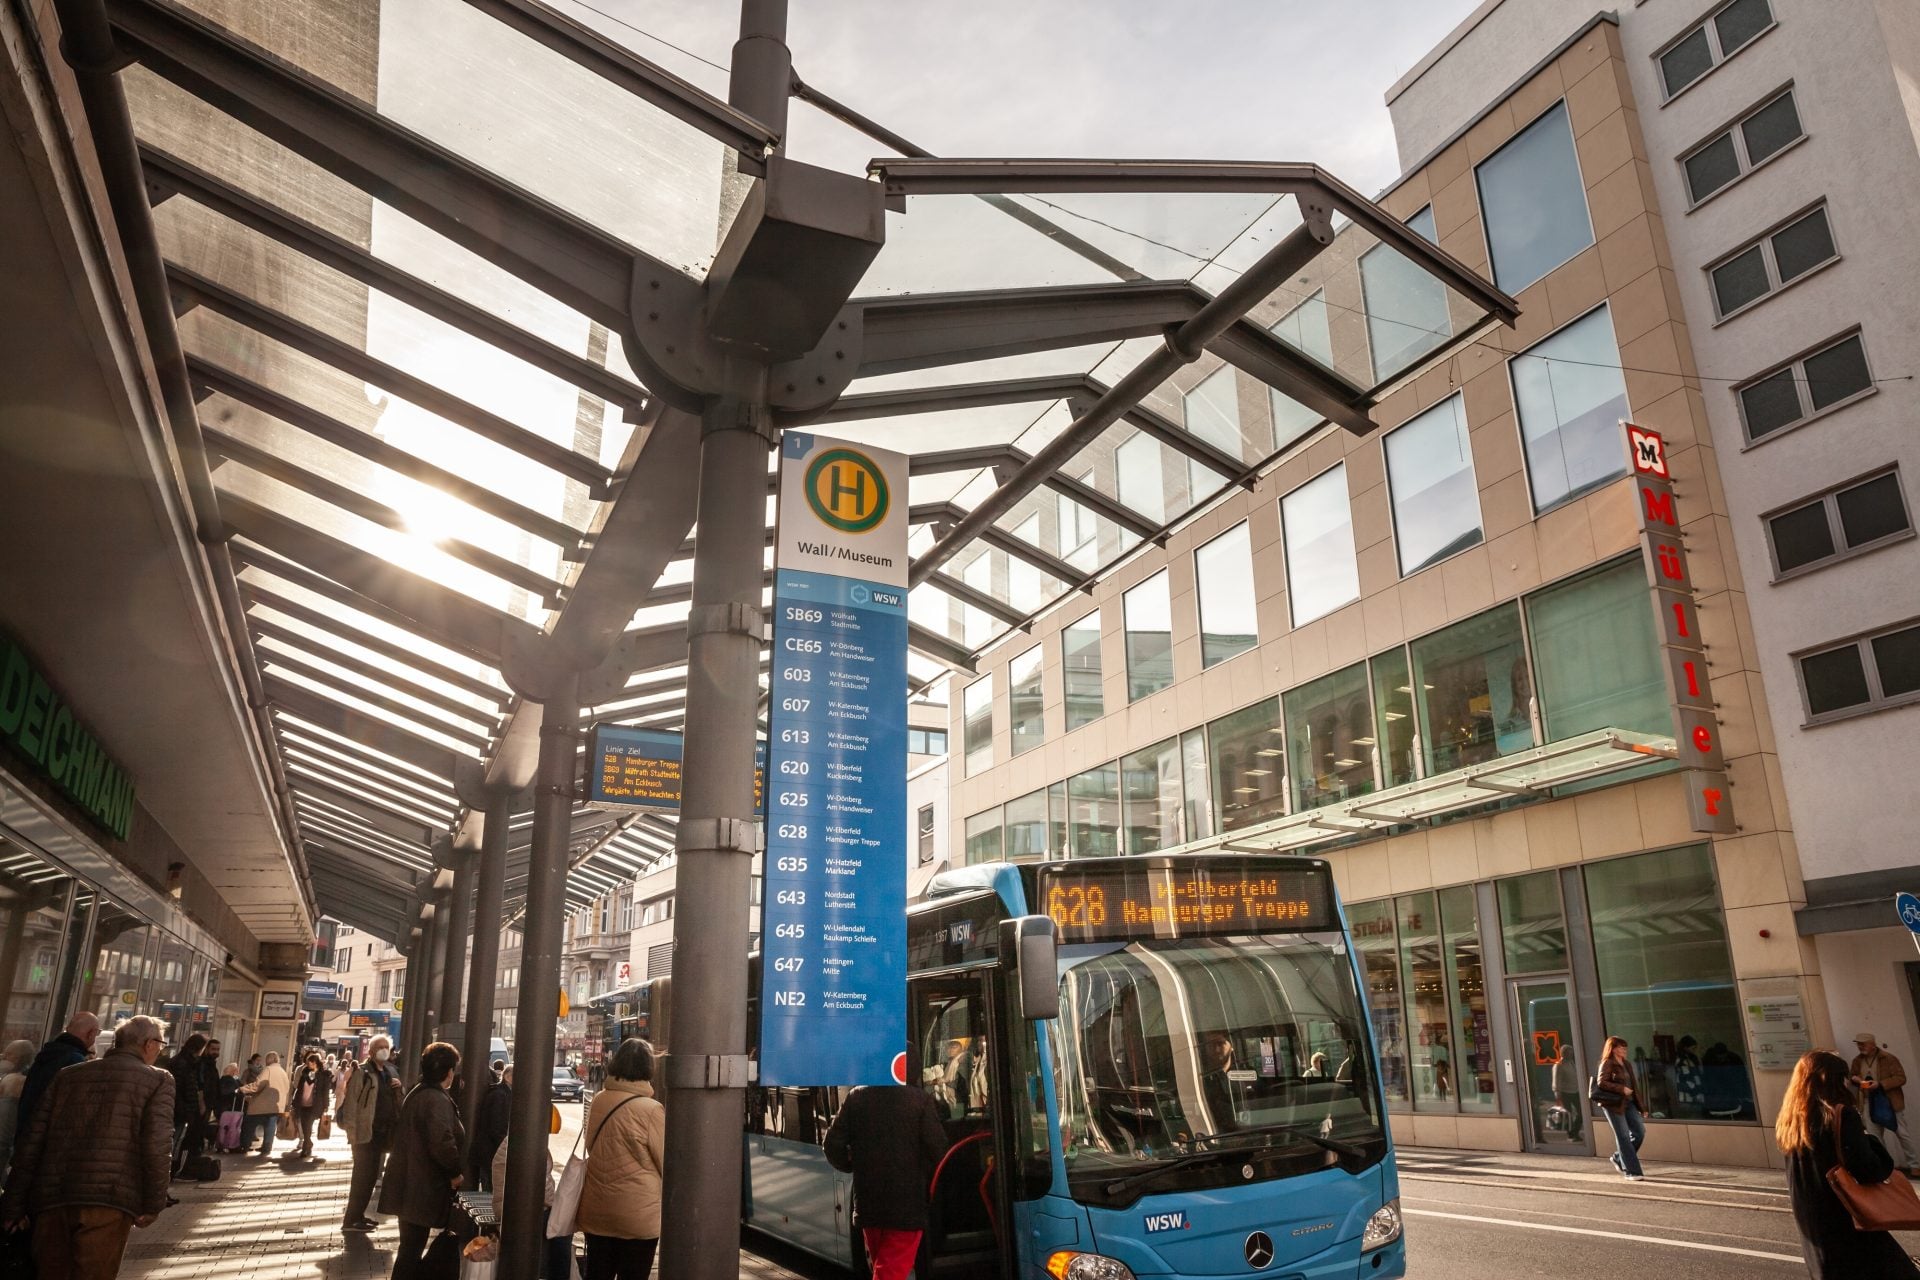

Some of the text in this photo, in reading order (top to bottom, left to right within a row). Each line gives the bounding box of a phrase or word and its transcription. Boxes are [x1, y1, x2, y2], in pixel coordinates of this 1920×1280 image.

[793, 437, 801, 449] 1
[1638, 441, 1658, 464] M
[830, 465, 865, 516] H
[873, 592, 898, 605] WSW
[786, 607, 823, 623] SB69
[831, 611, 857, 621] Wülfrath
[830, 620, 861, 630] Stadtmitte
[785, 637, 822, 653] CE65
[829, 641, 864, 653] W-Dönberg
[829, 650, 875, 662] Am Handweiser
[1642, 487, 1722, 817] Müller
[783, 667, 811, 682] 603
[829, 671, 870, 683] W-Katernberg
[828, 680, 868, 690] Am Eckbusch
[782, 698, 810, 712] 607
[828, 701, 870, 713] W-Katernberg
[828, 710, 867, 720] Am Eckbusch
[0, 643, 136, 842] DEICHMANN
[781, 729, 809, 744] 613
[827, 732, 869, 744] W-Katernberg
[605, 745, 641, 755] Linie Ziel
[827, 741, 867, 752] Am Eckbusch
[626, 756, 658, 768] Hamburger
[660, 760, 679, 769] Treppe
[780, 760, 809, 775] 620
[827, 762, 862, 772] W-Elberfeld
[650, 770, 680, 779] Stadtmitte
[827, 772, 862, 783] Kuckelsberg
[624, 777, 634, 785] Am
[635, 778, 662, 788] Eckbusch
[779, 792, 808, 807] 625
[826, 794, 862, 805] W-Dönberg
[839, 805, 874, 814] Handweiser
[778, 824, 808, 839] 628
[825, 826, 861, 835] W-Elberfeld
[825, 836, 881, 847] Hamburger Treppe
[777, 856, 808, 872] 635
[825, 858, 862, 867] W-Hatzfeld
[825, 867, 855, 875] Markland
[824, 891, 855, 899] Nordstadt
[1157, 879, 1278, 899] W-Elberfeld
[777, 890, 806, 905] 643
[824, 901, 856, 909] Lutherstift
[1050, 885, 1107, 926] 628
[1242, 896, 1311, 919] Treppe
[775, 923, 805, 939] 645
[823, 924, 865, 933] W-Uellendahl
[951, 923, 970, 943] WSW
[823, 934, 877, 943] Raukamp Schleife
[774, 957, 804, 972] 647
[823, 958, 854, 967] Hattingen
[822, 967, 841, 975] Mitte
[775, 991, 806, 1006] NE2
[823, 991, 867, 1000] W-Katernberg
[823, 1001, 864, 1009] Am Eckbusch
[1145, 1213, 1183, 1232] WSW
